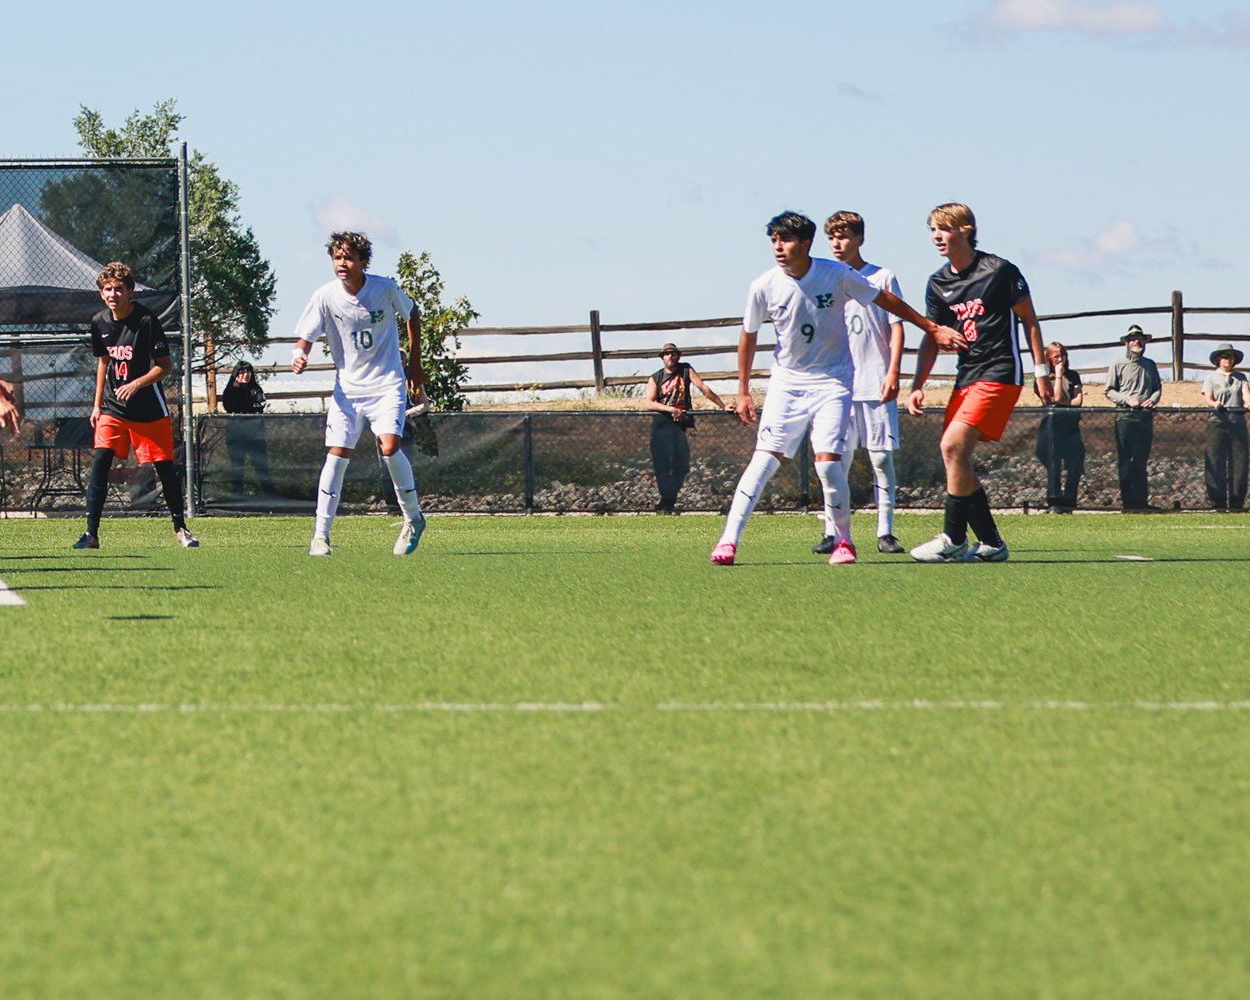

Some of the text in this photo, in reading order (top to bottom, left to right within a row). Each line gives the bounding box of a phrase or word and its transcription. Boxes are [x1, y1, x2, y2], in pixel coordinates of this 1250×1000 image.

[351, 330, 374, 350] 10
[800, 323, 815, 344] 9
[114, 361, 129, 381] 14
